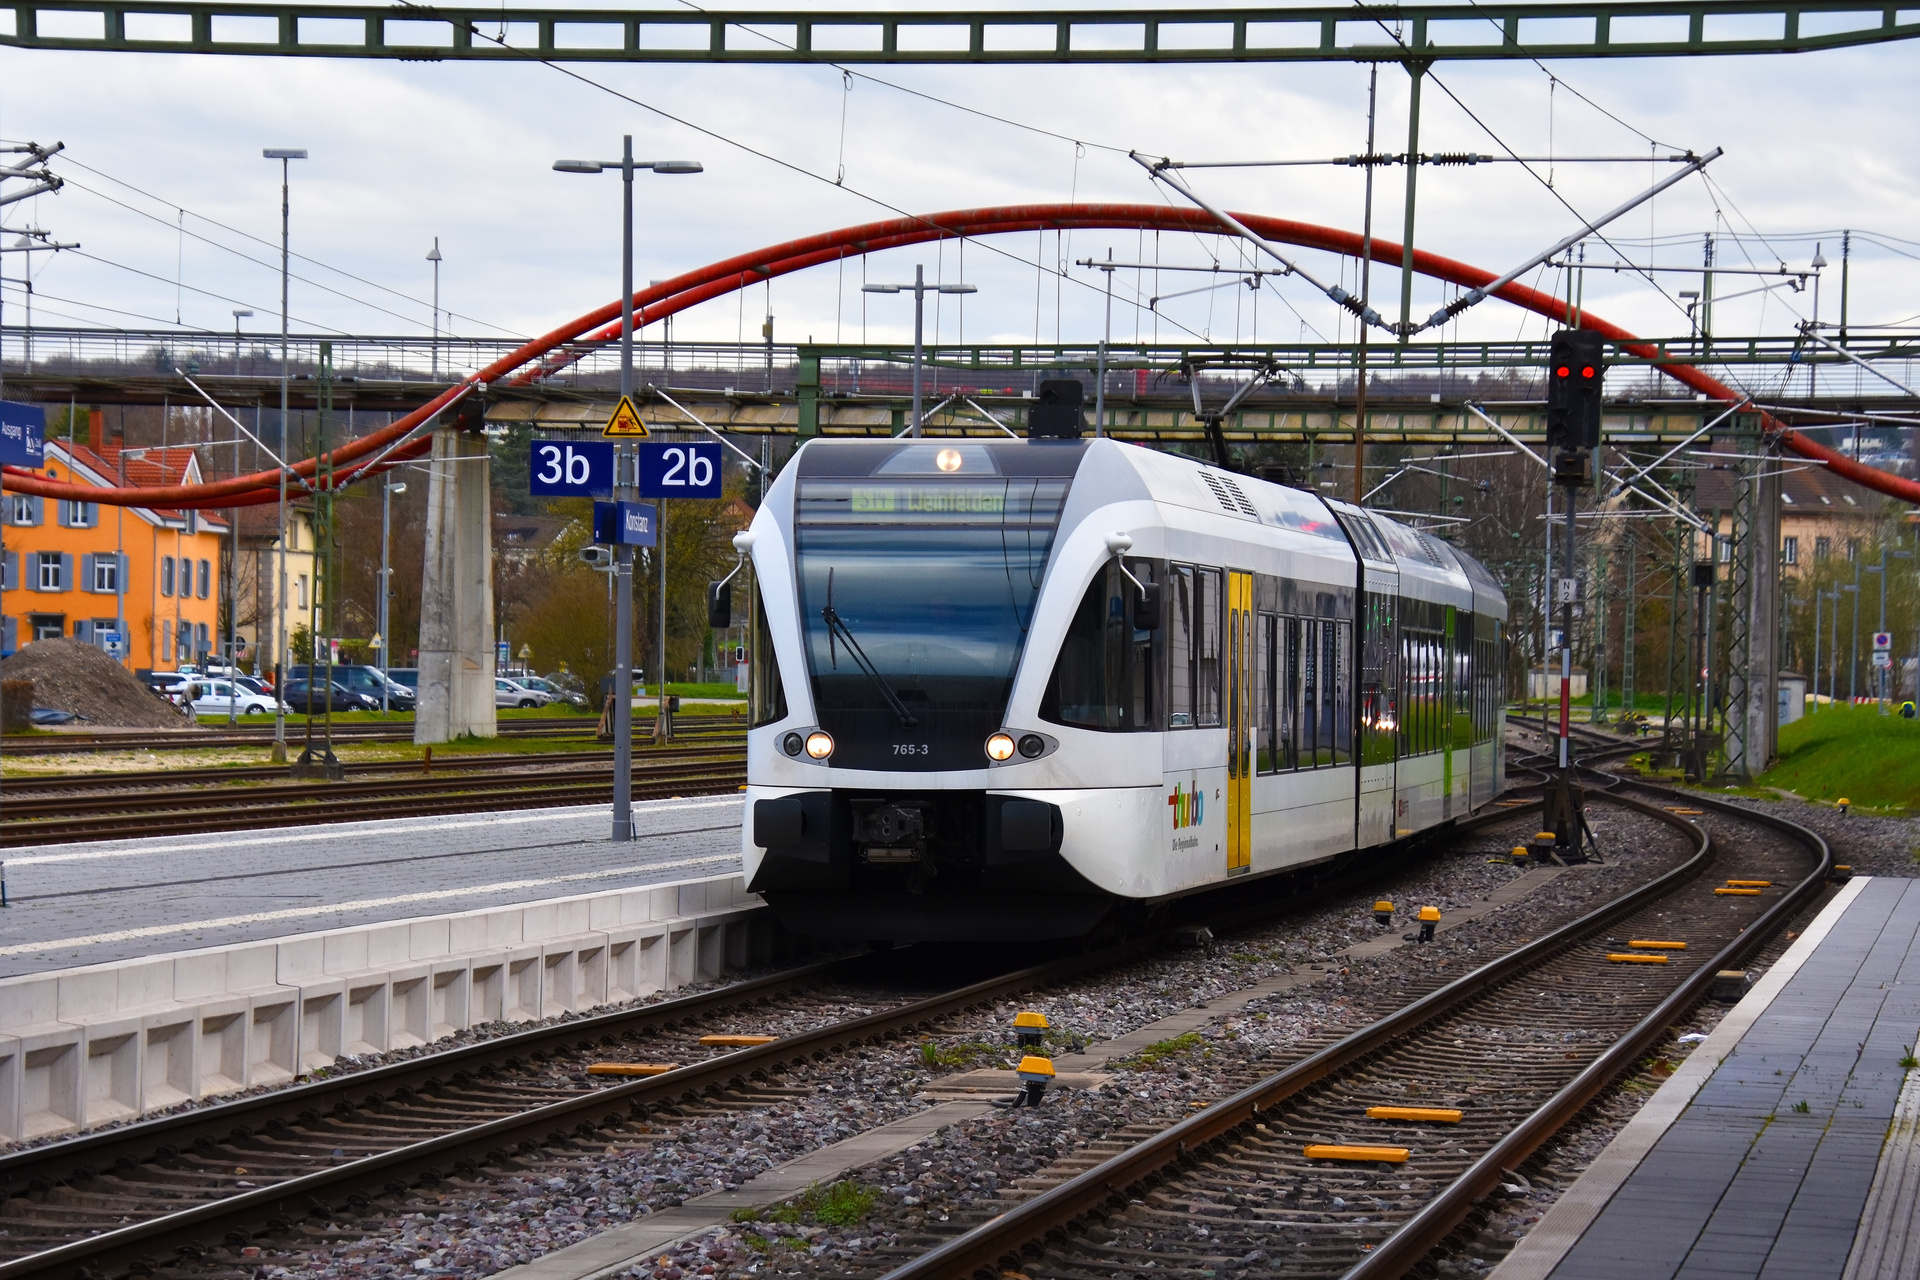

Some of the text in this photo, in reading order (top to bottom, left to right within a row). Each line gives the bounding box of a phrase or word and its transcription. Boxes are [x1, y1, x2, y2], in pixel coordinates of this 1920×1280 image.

[537, 445, 591, 485] 3b
[661, 447, 713, 486] 2b
[908, 488, 1004, 512] Weinfelden
[625, 509, 649, 533] Konstanz
[1563, 581, 1570, 590] N
[1563, 591, 1570, 601] 2
[892, 744, 929, 755] 765-3
